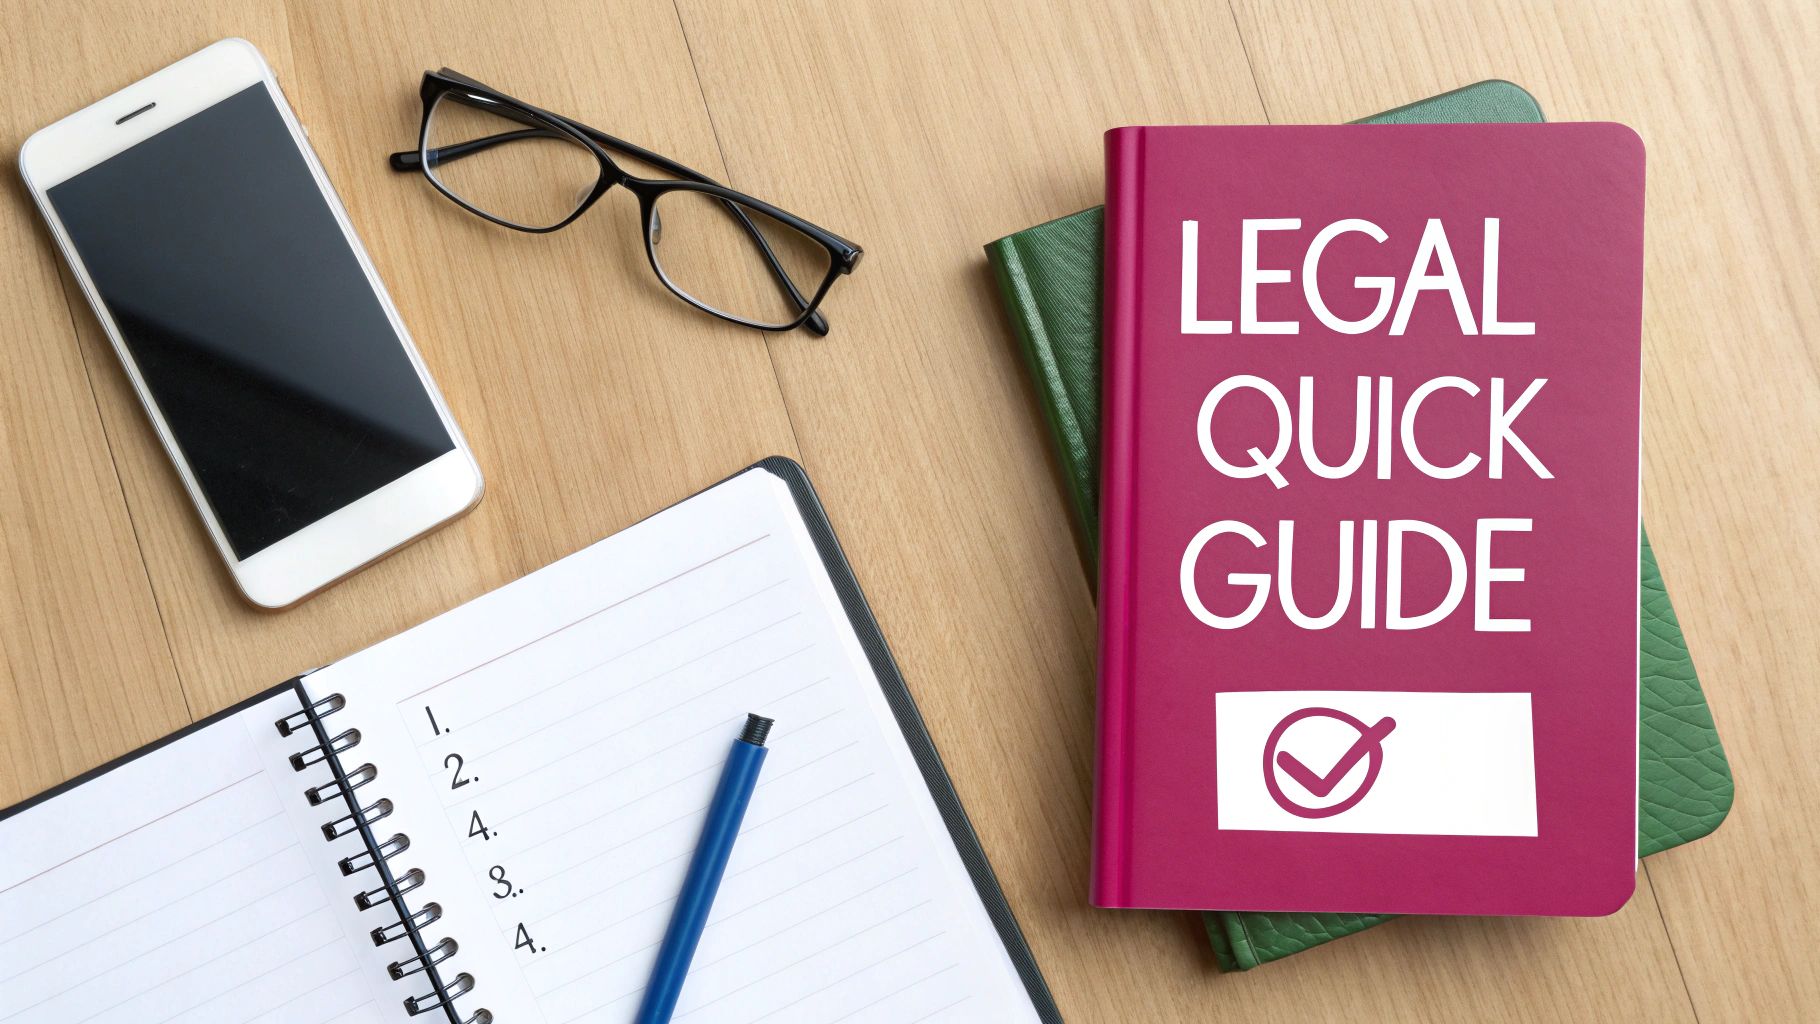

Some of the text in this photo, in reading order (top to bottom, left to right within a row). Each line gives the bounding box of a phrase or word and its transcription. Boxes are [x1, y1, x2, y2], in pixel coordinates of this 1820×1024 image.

[1180, 217, 1536, 336] LEGAL
[1196, 374, 1555, 490] QUICK
[1179, 517, 1534, 633] GUIDE
[425, 706, 451, 736] 1.
[444, 753, 480, 790] 2.
[468, 810, 499, 841] 4.
[514, 922, 547, 954] 4.
